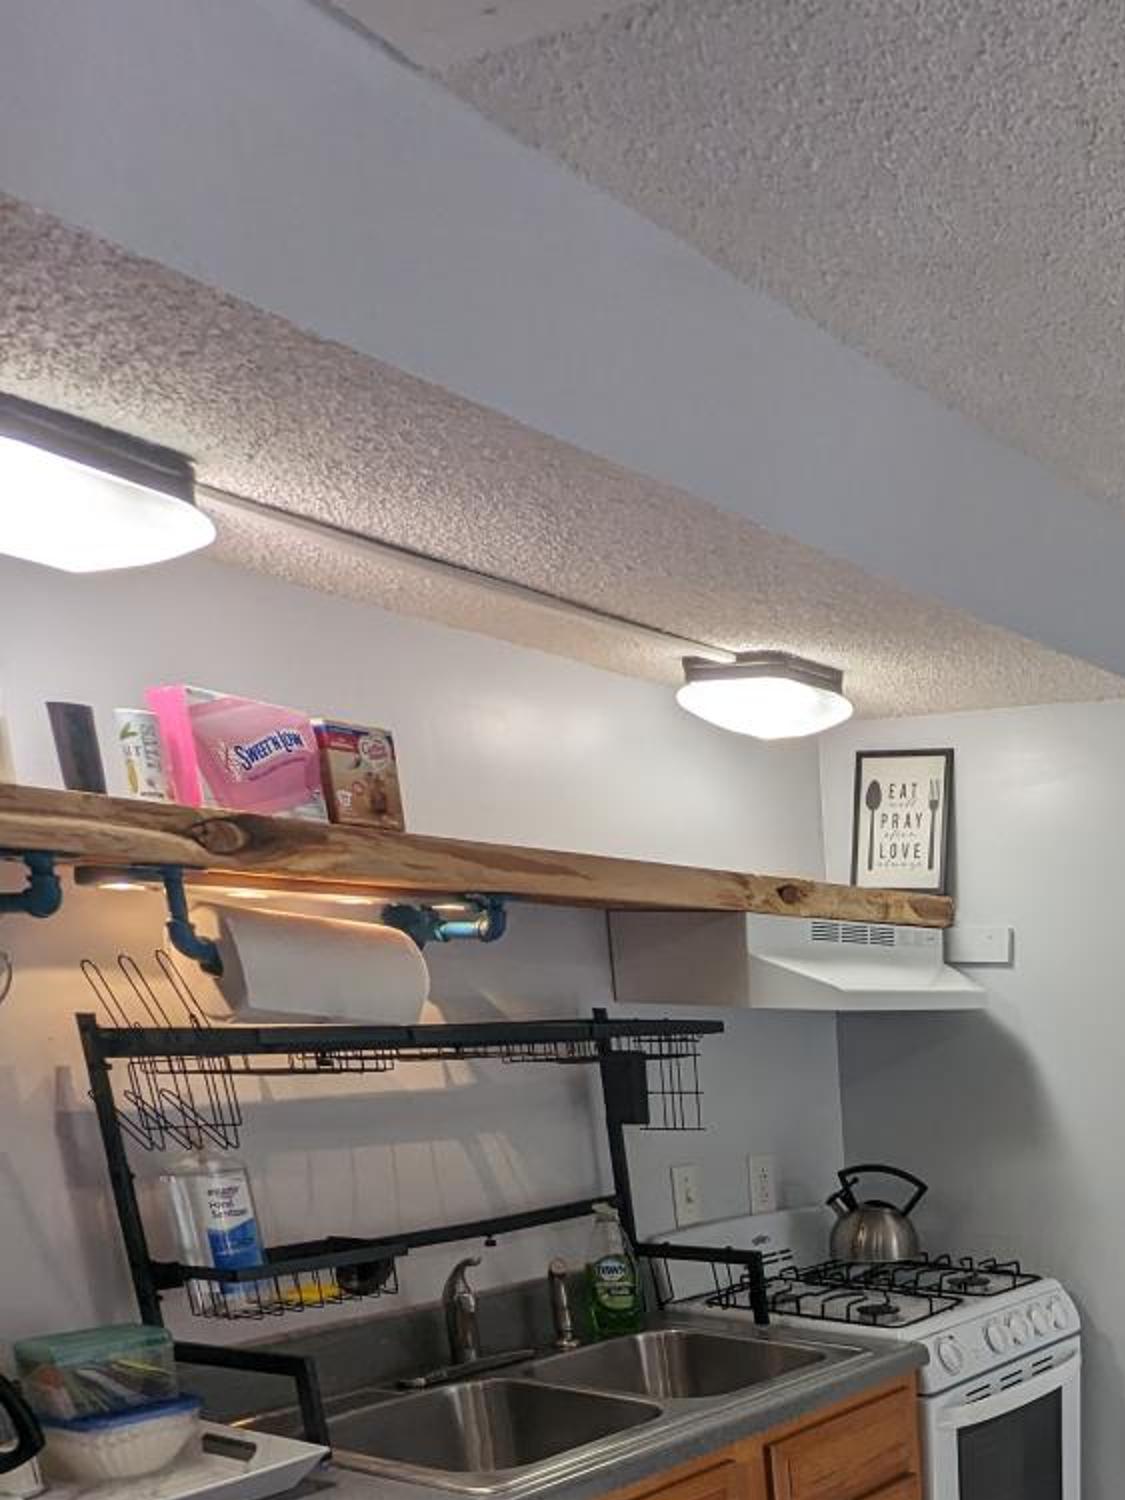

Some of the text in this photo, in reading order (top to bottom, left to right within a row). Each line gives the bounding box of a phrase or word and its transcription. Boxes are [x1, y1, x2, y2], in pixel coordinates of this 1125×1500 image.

[888, 783, 918, 799] EAT
[880, 812, 923, 830] PRAY
[880, 842, 922, 859] LOVE
